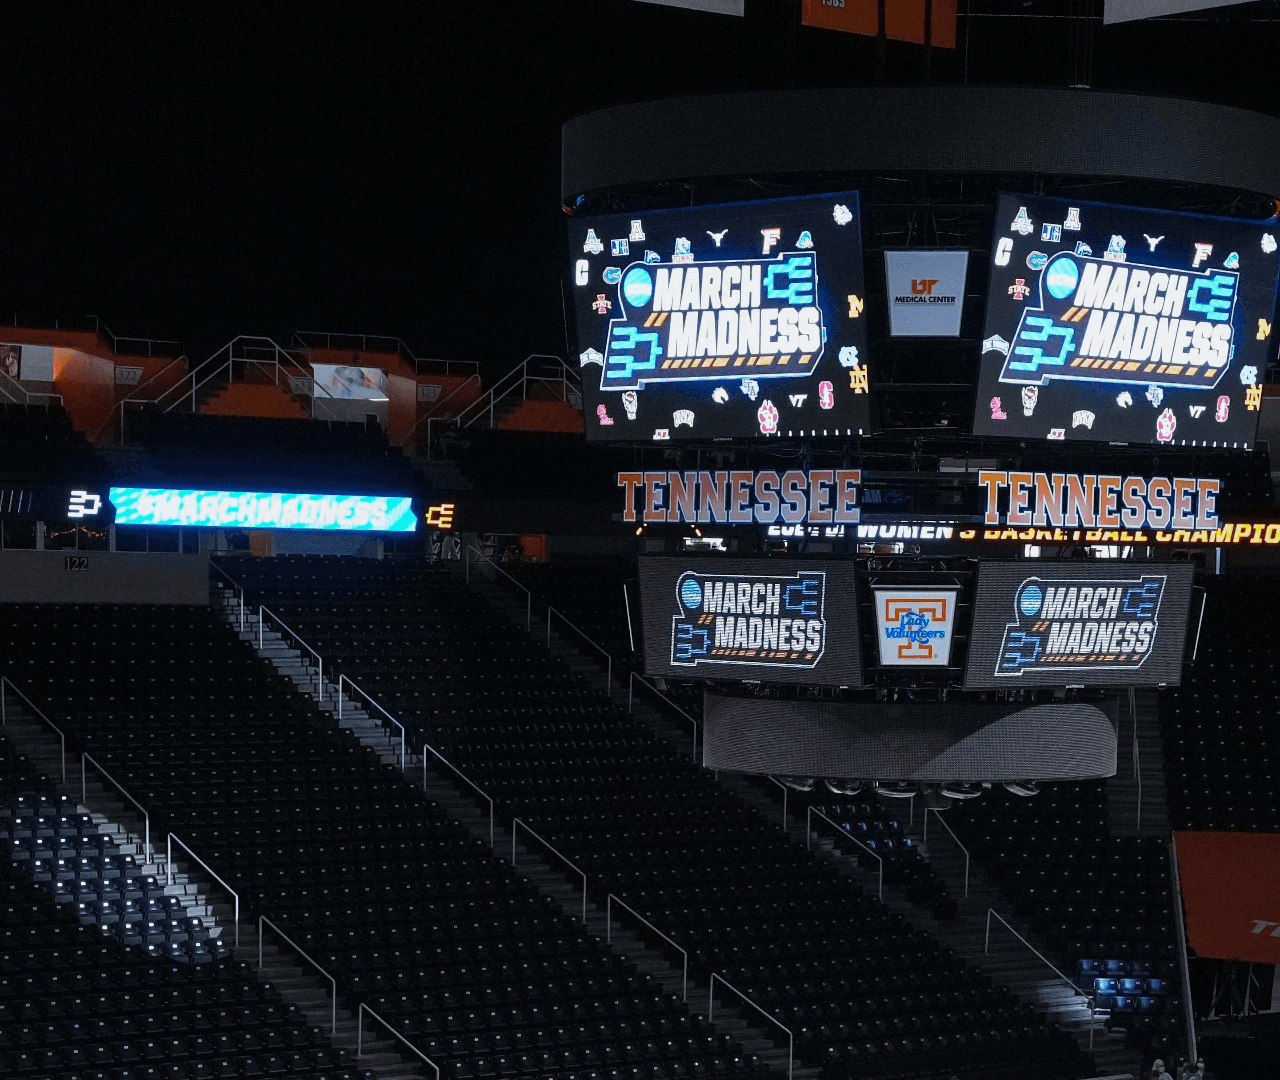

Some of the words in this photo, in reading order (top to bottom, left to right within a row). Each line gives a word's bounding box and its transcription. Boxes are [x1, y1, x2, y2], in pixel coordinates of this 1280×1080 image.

[653, 264, 761, 311] MARCH
[1073, 263, 1188, 317] MARCH
[667, 306, 821, 358] MADNESS
[1080, 309, 1232, 367] MADNESS
[617, 469, 862, 523] TENNESSEE
[978, 469, 1221, 531] TENNESSEE
[65, 557, 88, 571] 122
[703, 581, 781, 615] MARCH
[1040, 587, 1123, 618] MARCH
[714, 616, 820, 651] MADNESS
[885, 625, 946, 644] Volunteers
[899, 611, 931, 630] Lady
[1045, 621, 1153, 654] MADNESS
